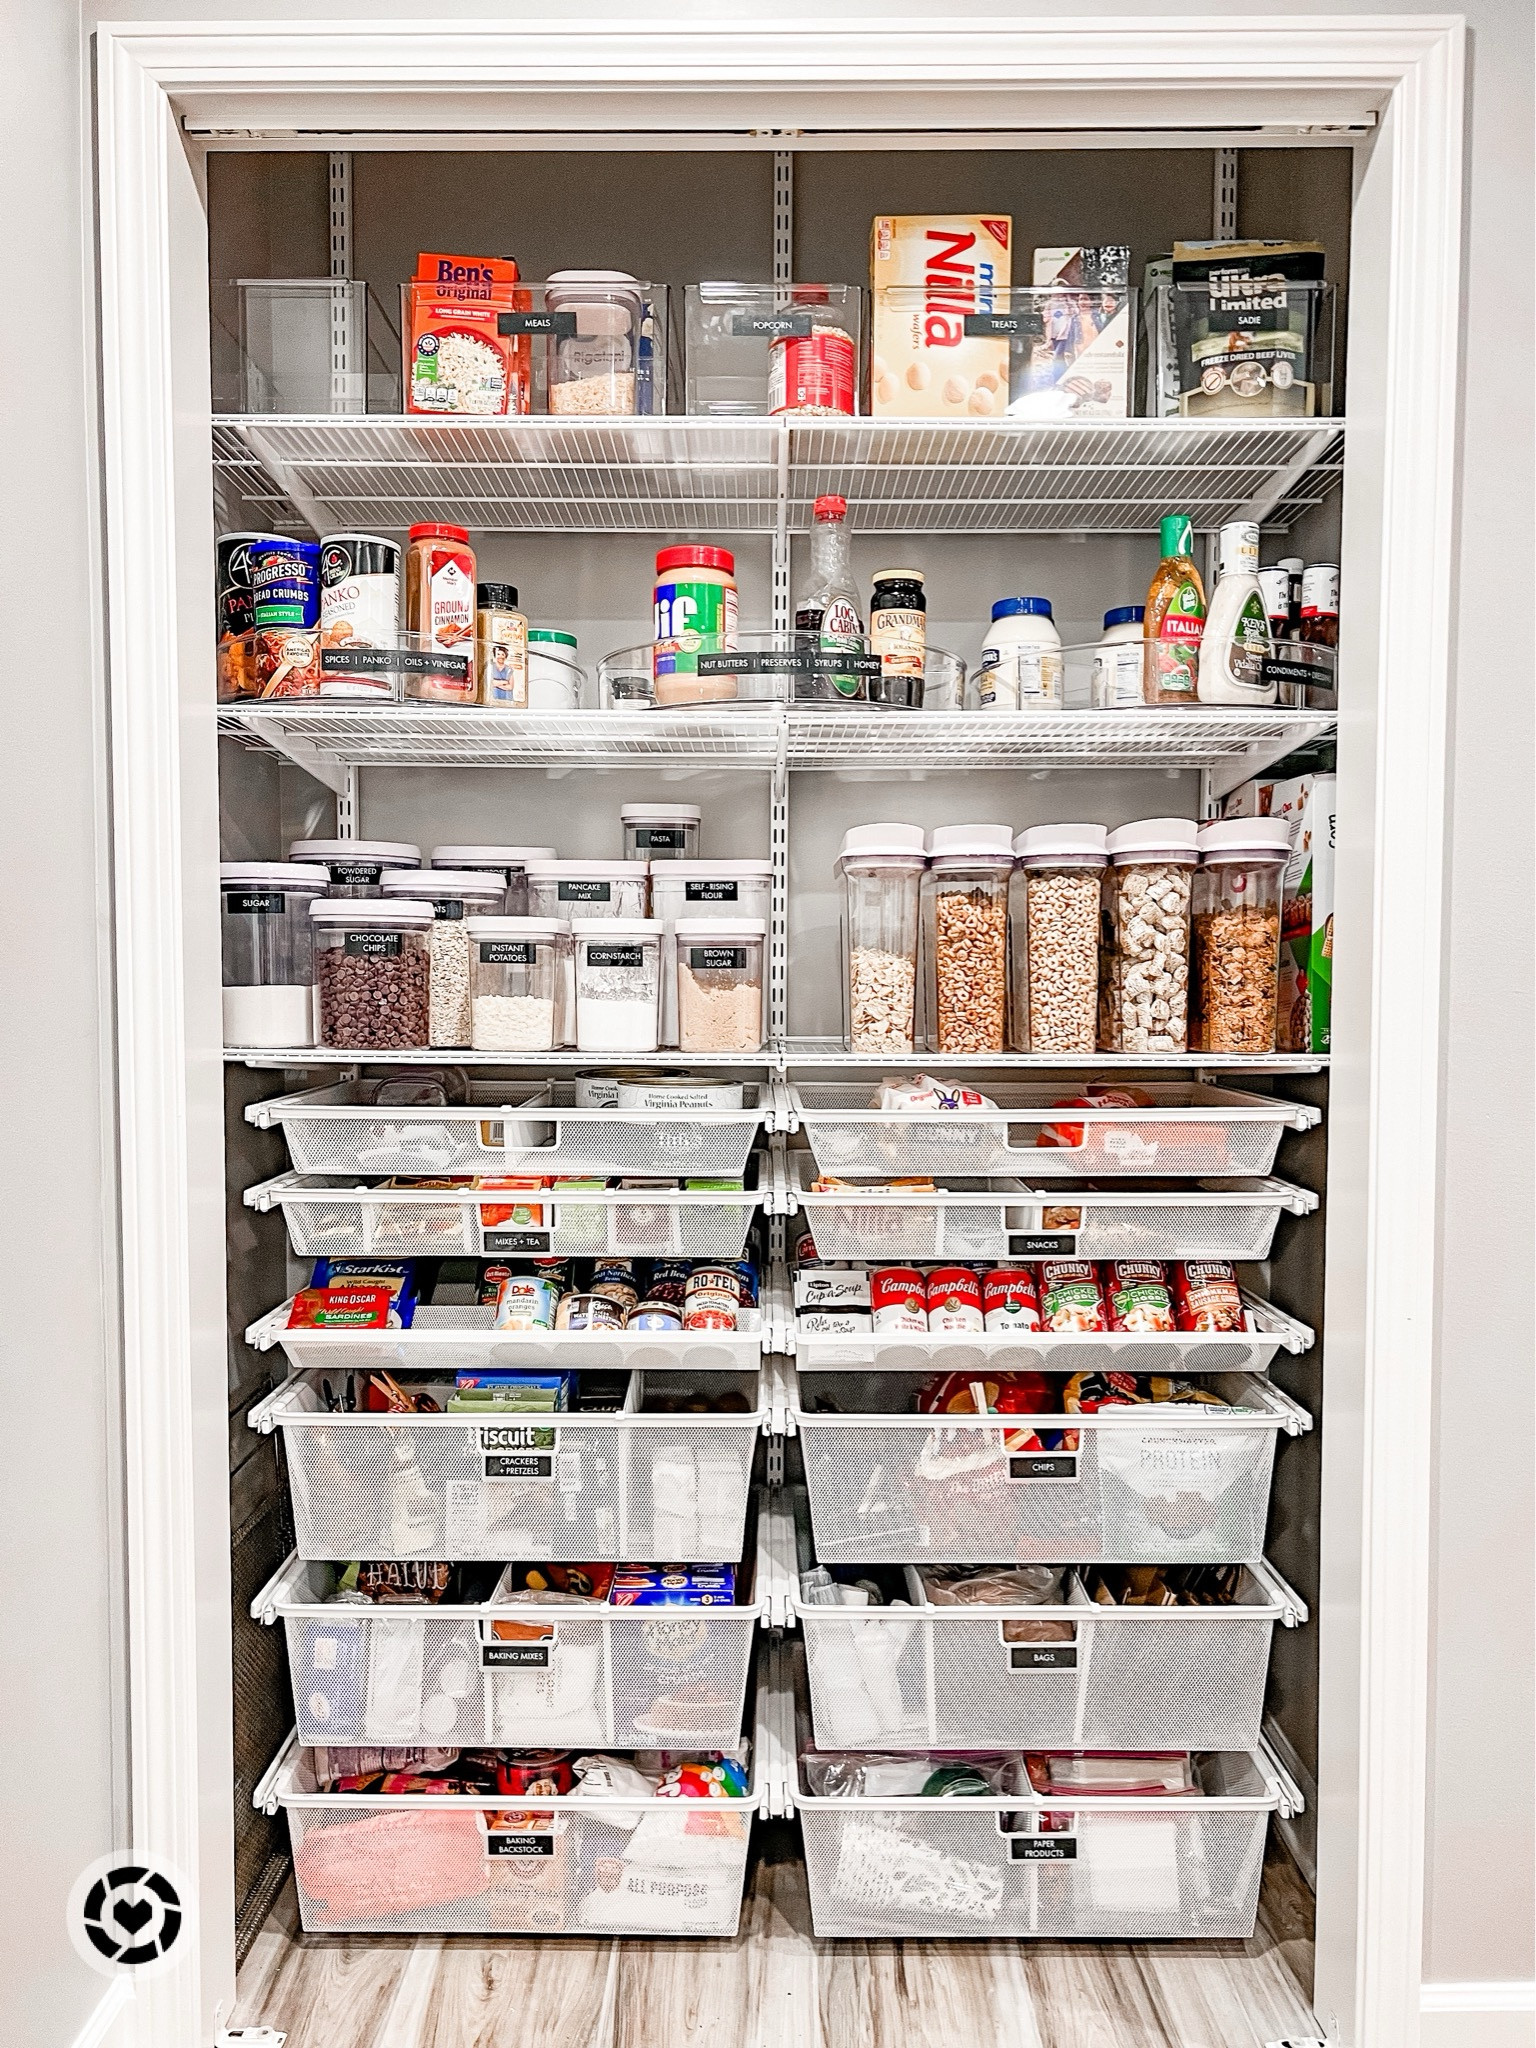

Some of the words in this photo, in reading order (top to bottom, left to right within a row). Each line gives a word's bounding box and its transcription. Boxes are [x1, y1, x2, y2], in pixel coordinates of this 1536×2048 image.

[437, 259, 494, 282] Ben's
[436, 284, 492, 301] Original
[925, 230, 977, 349] Nilla
[1210, 291, 1288, 311] limited
[453, 309, 472, 317] GRAIN
[472, 310, 491, 318] WHITE
[525, 319, 551, 328] MEALS
[990, 320, 1018, 330] TREATS
[1238, 316, 1262, 325] SADIE
[753, 321, 793, 330] POPCORN
[912, 314, 920, 350] wafers
[1201, 354, 1230, 367] FREEZE
[1230, 353, 1255, 362] DRIED
[1256, 351, 1276, 360] BEEF
[1276, 350, 1296, 360] LIVER
[253, 563, 306, 586] PROGRESSO
[272, 588, 309, 602] CRUMBS
[321, 585, 360, 610] ANKO
[834, 604, 854, 622] LOG
[434, 613, 469, 626] CINNAMON
[830, 618, 859, 634] CABIN
[324, 655, 350, 664] SPICES
[362, 656, 392, 665] PANKO
[404, 657, 423, 667] OILS
[431, 660, 467, 671] VINEGAR
[700, 660, 716, 670] NUT
[717, 659, 749, 668] BUTTERS
[760, 658, 802, 667] PRESERVES
[814, 659, 843, 668] SYRUPS
[853, 660, 880, 670] HONEY
[1266, 665, 1307, 678] CONDIMENTS
[650, 835, 671, 843] PASTA
[337, 867, 377, 876] POWDERED
[345, 876, 370, 884] SUGAR
[568, 883, 602, 891] PANCAKE
[578, 892, 592, 900] MIX
[701, 891, 724, 900] FLOUR
[242, 899, 270, 908] SUGAR
[434, 905, 447, 914] ATS
[350, 934, 399, 943] CHOCOLATE
[362, 944, 387, 953] CHIPS
[491, 944, 525, 952] INSTANT
[489, 953, 527, 962] POTATOES
[589, 952, 641, 960] CORNSTARCH
[703, 949, 735, 958] BROWN
[705, 958, 733, 967] SUGAR
[644, 1100, 678, 1109] Virginia
[679, 1100, 714, 1108] Peanuts
[495, 1238, 518, 1246] MIXES
[526, 1238, 540, 1246] TEA
[1026, 1241, 1059, 1250] SNACKS
[343, 1263, 404, 1275] StarKist
[1046, 1263, 1090, 1278] CHUNKY
[1118, 1263, 1162, 1278] CHUNKY
[1187, 1263, 1232, 1278] CHUNKY
[511, 1284, 536, 1294] Dole
[329, 1295, 349, 1304] KING
[349, 1294, 376, 1305] OSCAR
[697, 1291, 730, 1299] Original
[506, 1297, 539, 1305] mandarin
[325, 1312, 373, 1320] SARDINES
[1000, 1322, 1030, 1330] Toato
[499, 1457, 539, 1466] CRACKERS
[506, 1467, 539, 1475] PRETZELS
[1031, 1463, 1055, 1472] CHIPS
[488, 1651, 518, 1661] BAKING
[520, 1652, 544, 1661] MIXES
[1033, 1653, 1056, 1662] BAGS
[506, 1836, 536, 1845] BAKING
[1032, 1839, 1056, 1848] PAPER
[499, 1846, 543, 1854] BACKSTOCK
[1024, 1849, 1065, 1858] PRODUCTS
